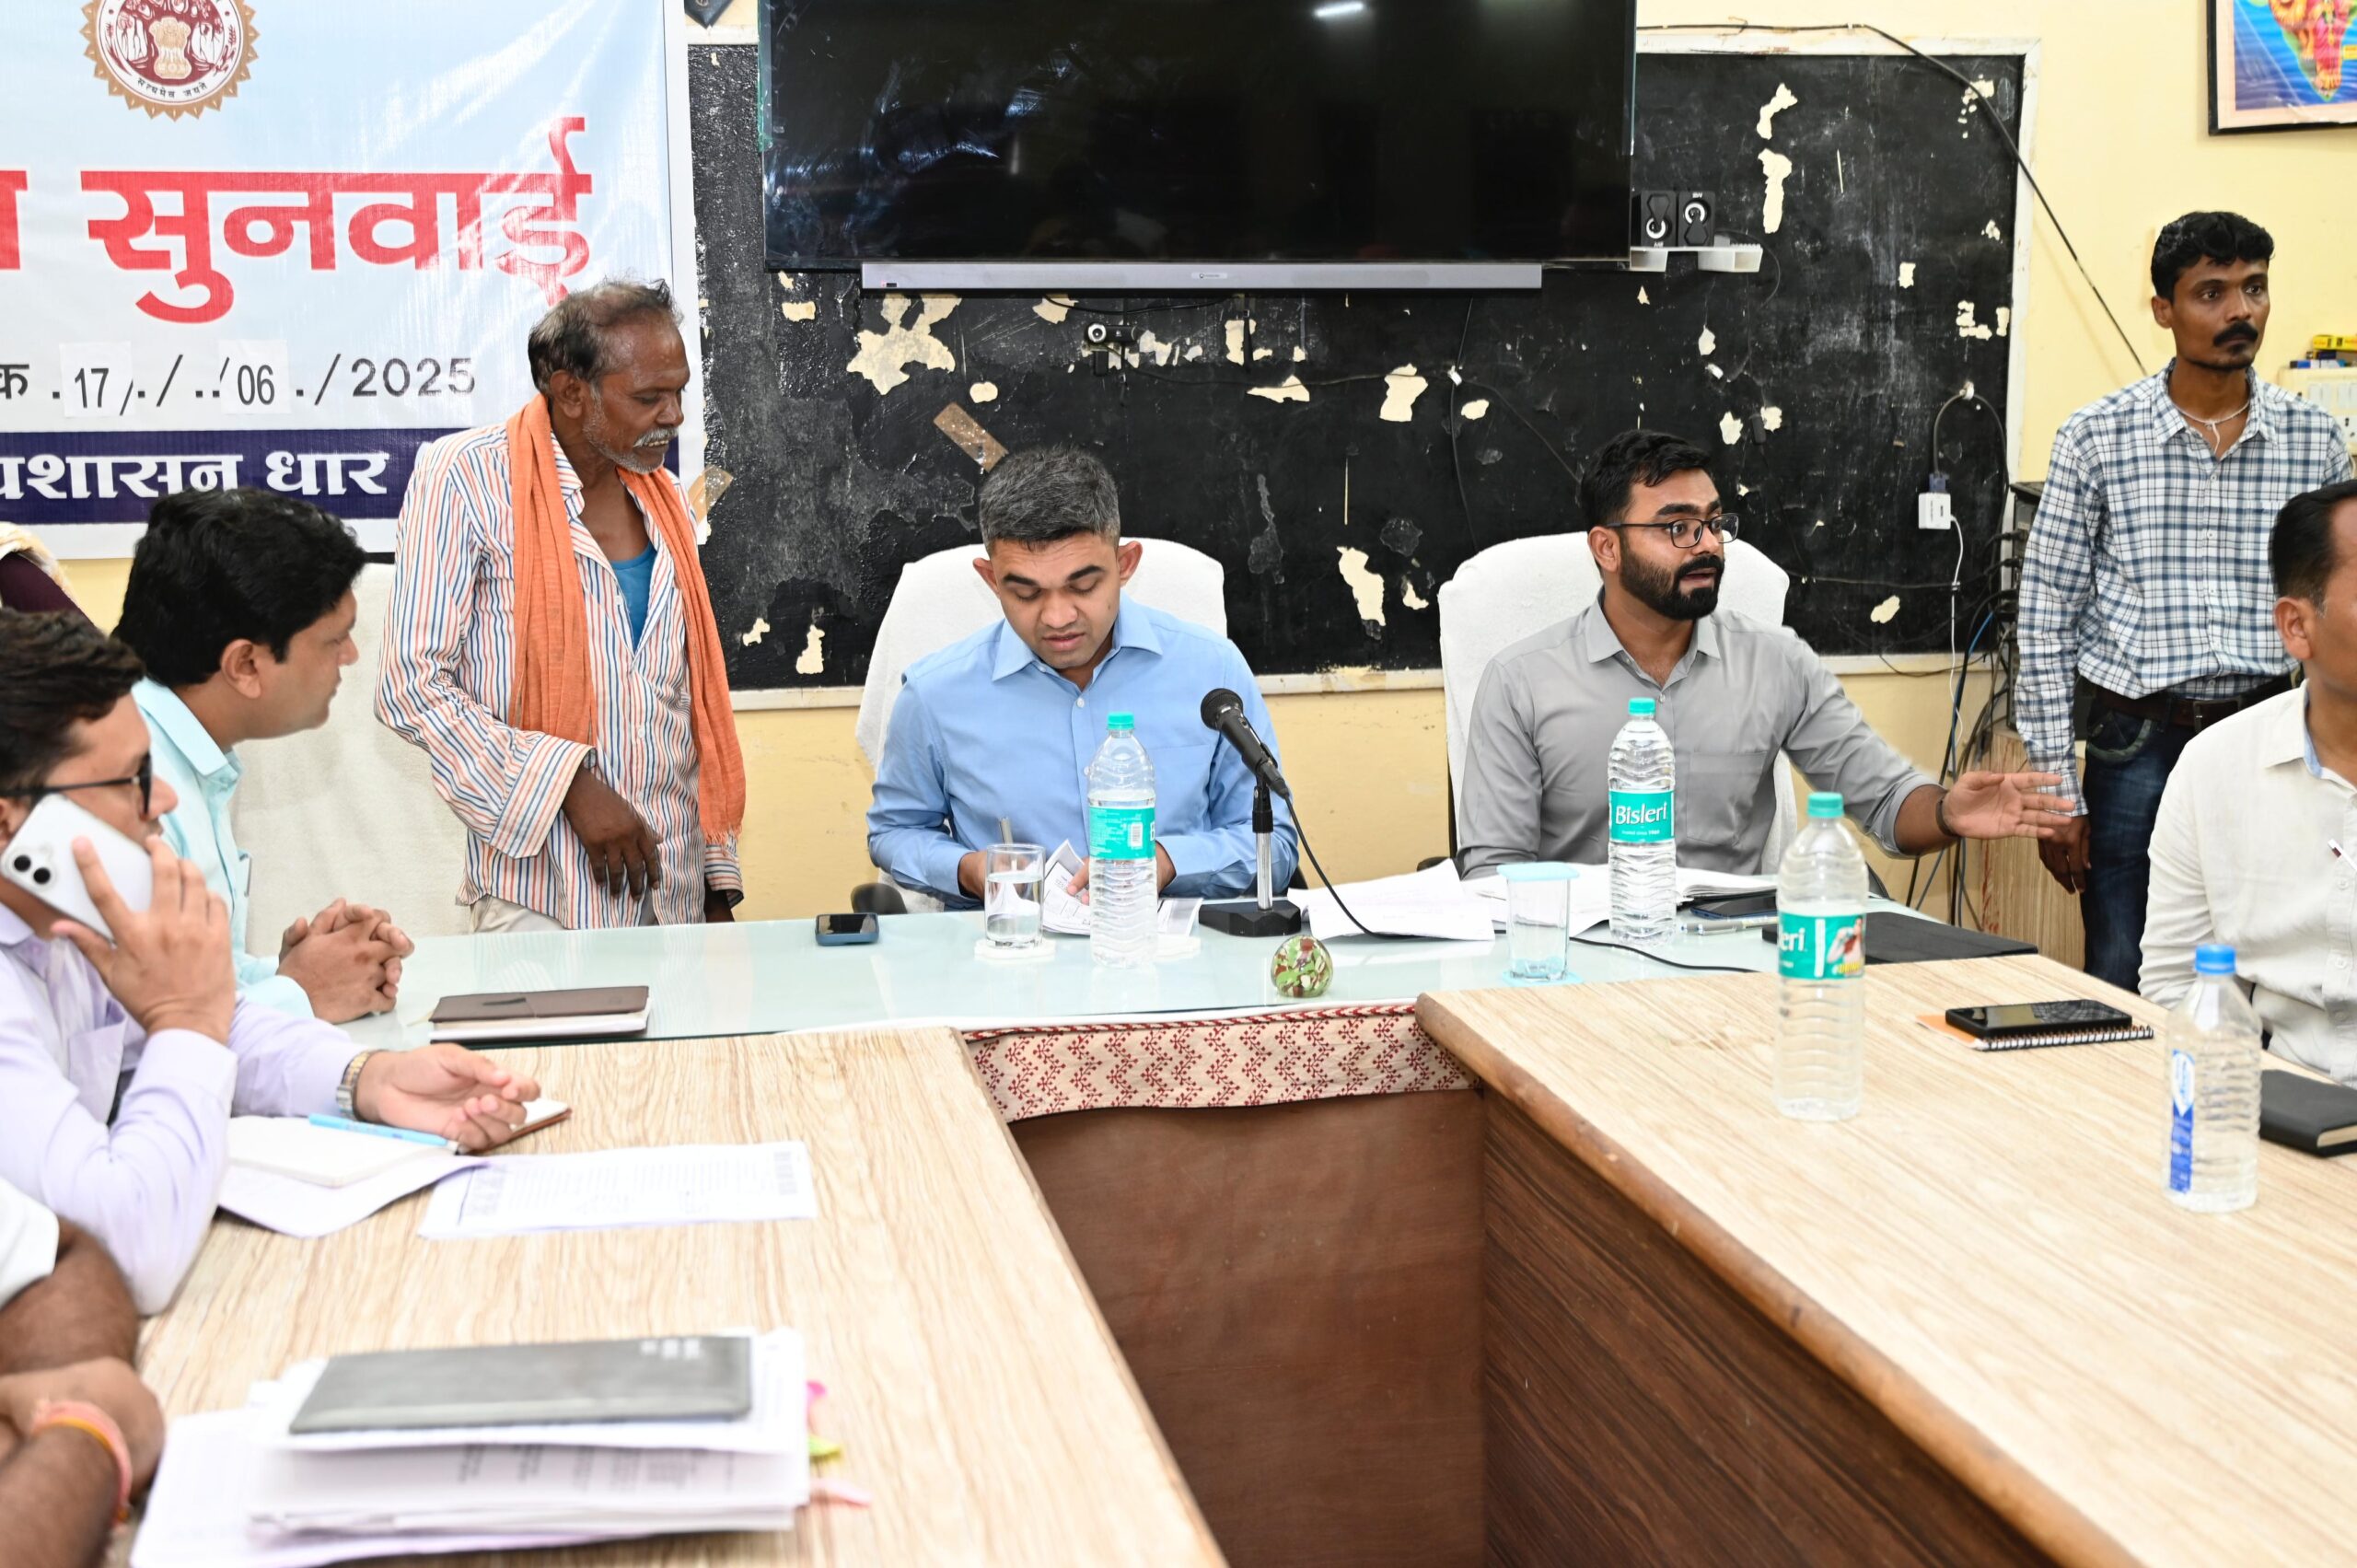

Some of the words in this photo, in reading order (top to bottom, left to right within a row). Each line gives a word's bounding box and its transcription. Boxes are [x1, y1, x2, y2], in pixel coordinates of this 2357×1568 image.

[80, 116, 593, 324] सुनवाई
[265, 450, 390, 495] धार
[1615, 802, 1667, 825] Bisleri
